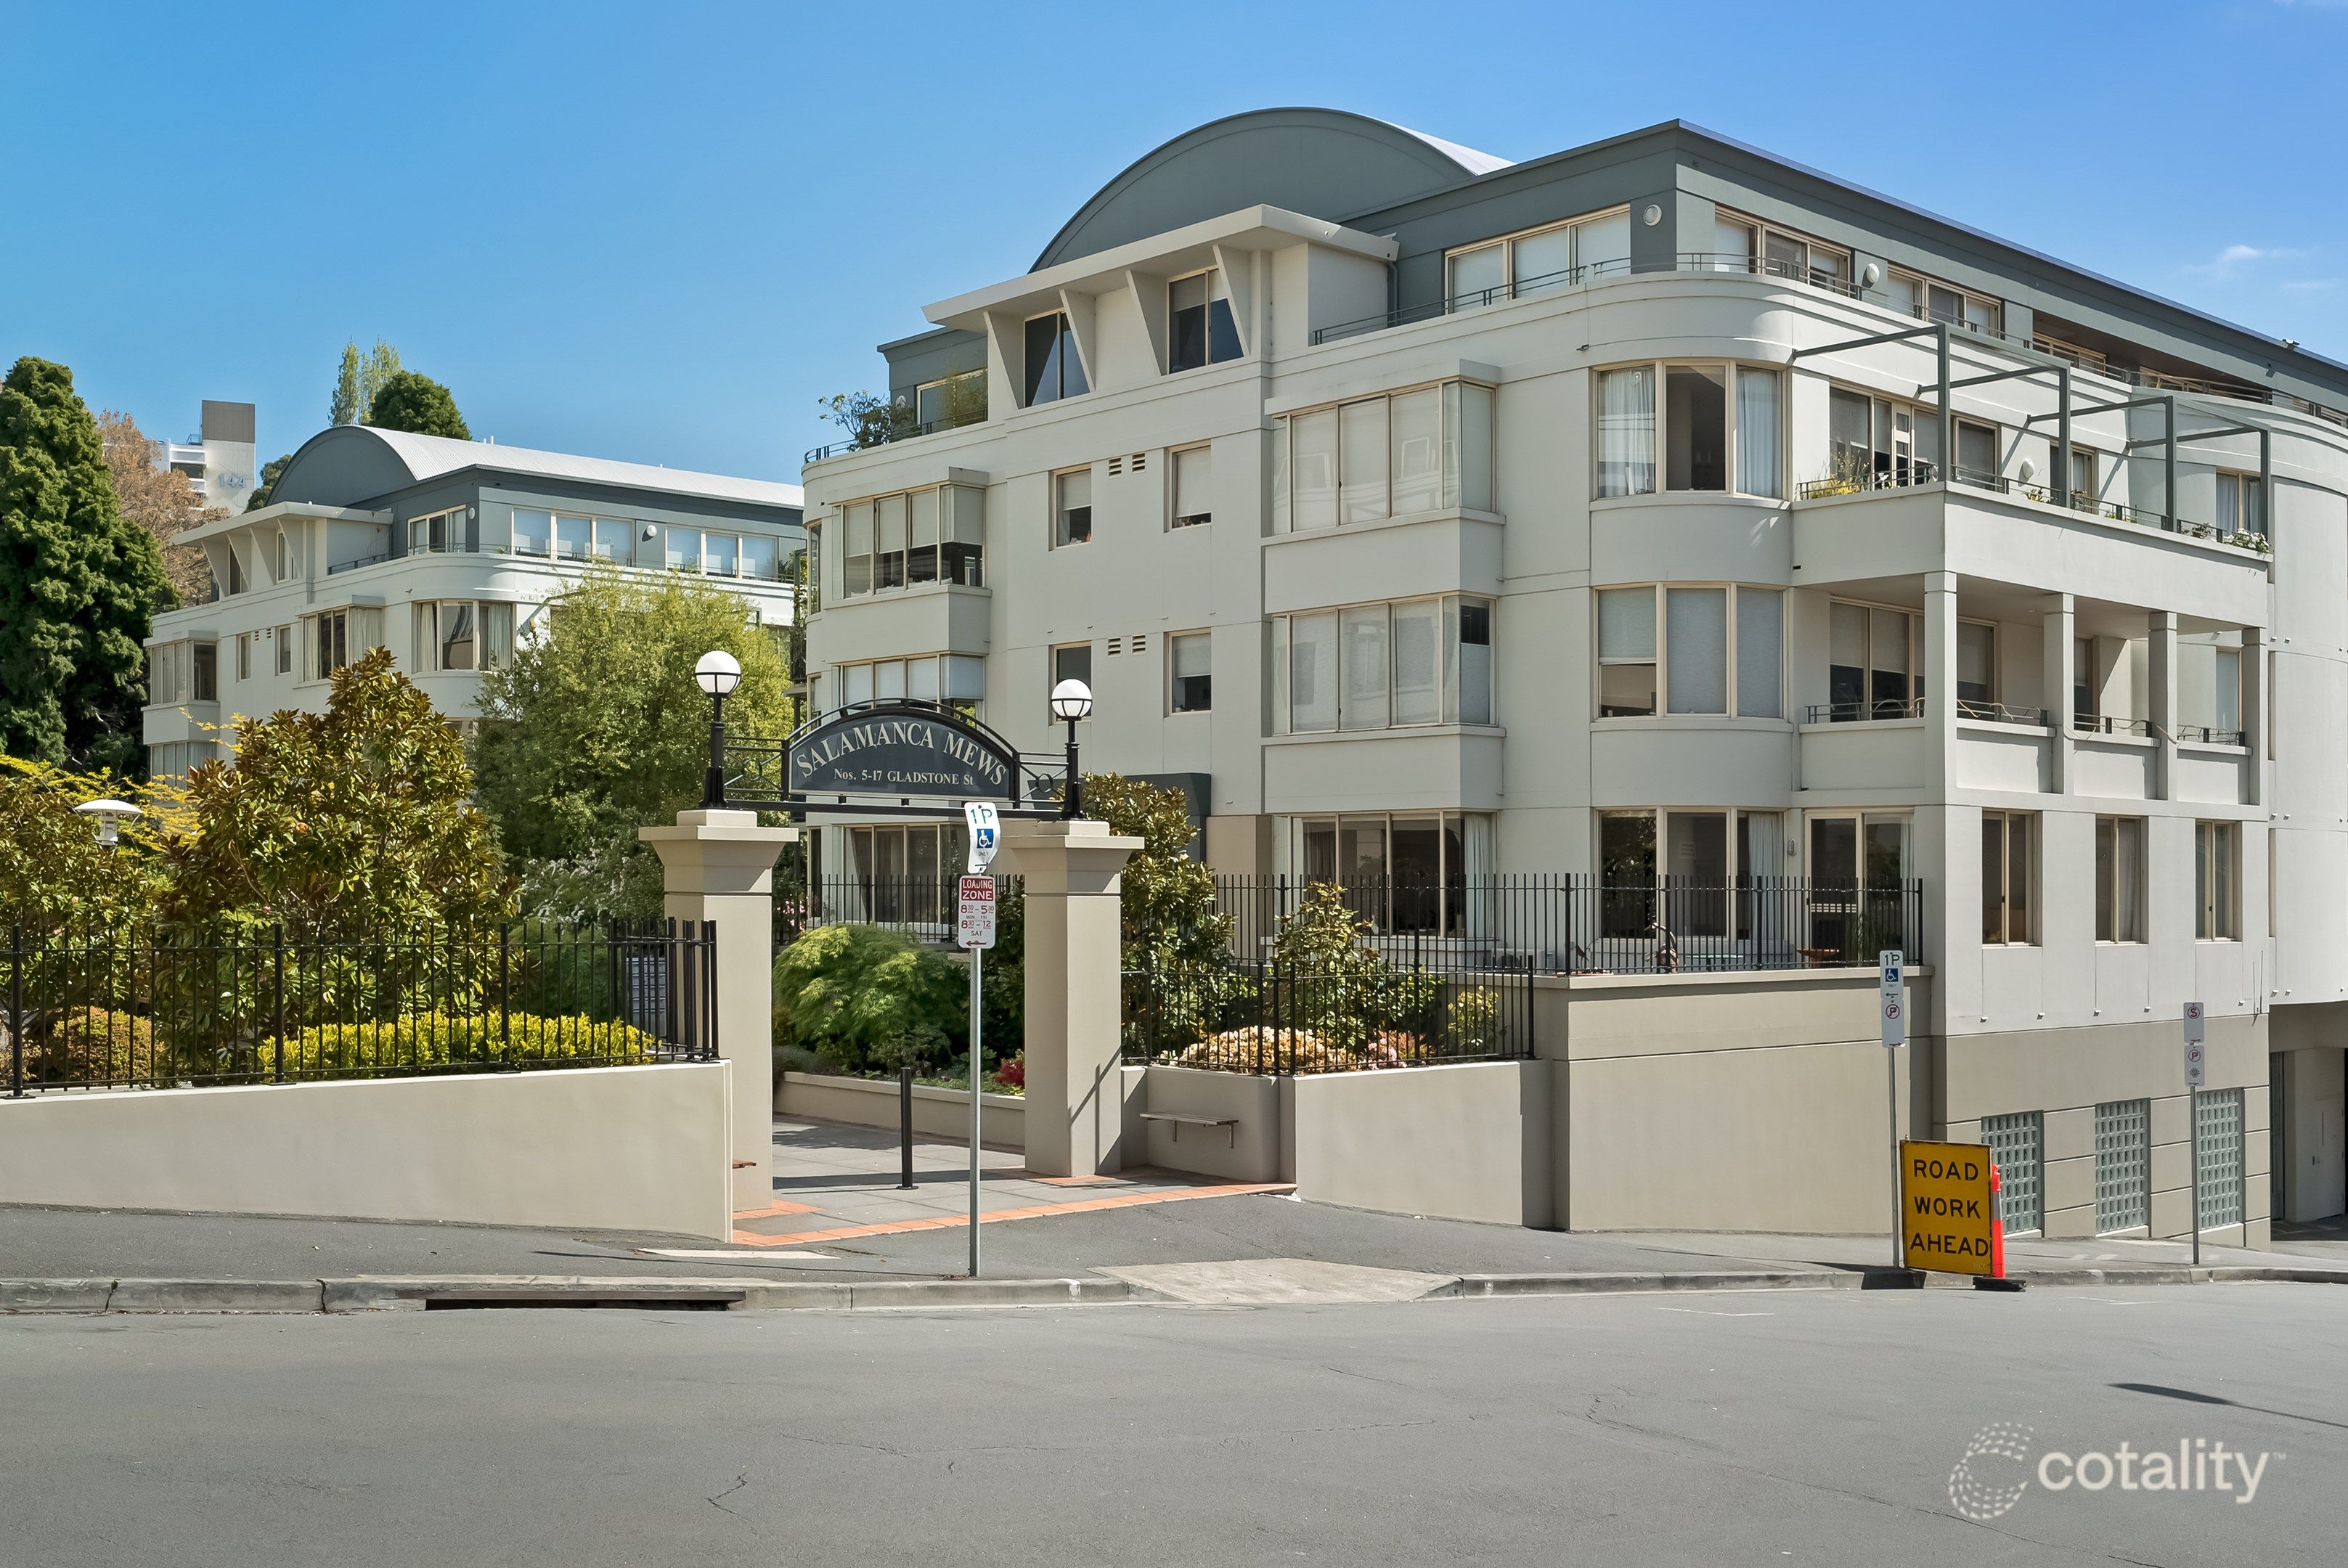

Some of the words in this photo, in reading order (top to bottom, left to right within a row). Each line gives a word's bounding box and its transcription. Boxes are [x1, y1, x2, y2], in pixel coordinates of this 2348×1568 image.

[219, 473, 246, 488] 144
[796, 722, 934, 778] SALAMANCA
[943, 731, 1006, 785] MEWS
[833, 768, 856, 780] Nos.
[861, 769, 882, 781] 5-17
[886, 770, 958, 785] GLADSTONE
[963, 774, 974, 785] St
[962, 890, 992, 900] ZONE
[1884, 954, 1900, 966] 1P
[1913, 1159, 1978, 1181] ROAD
[1914, 1196, 1981, 1219] WORK
[1909, 1233, 1989, 1257] AHEAD
